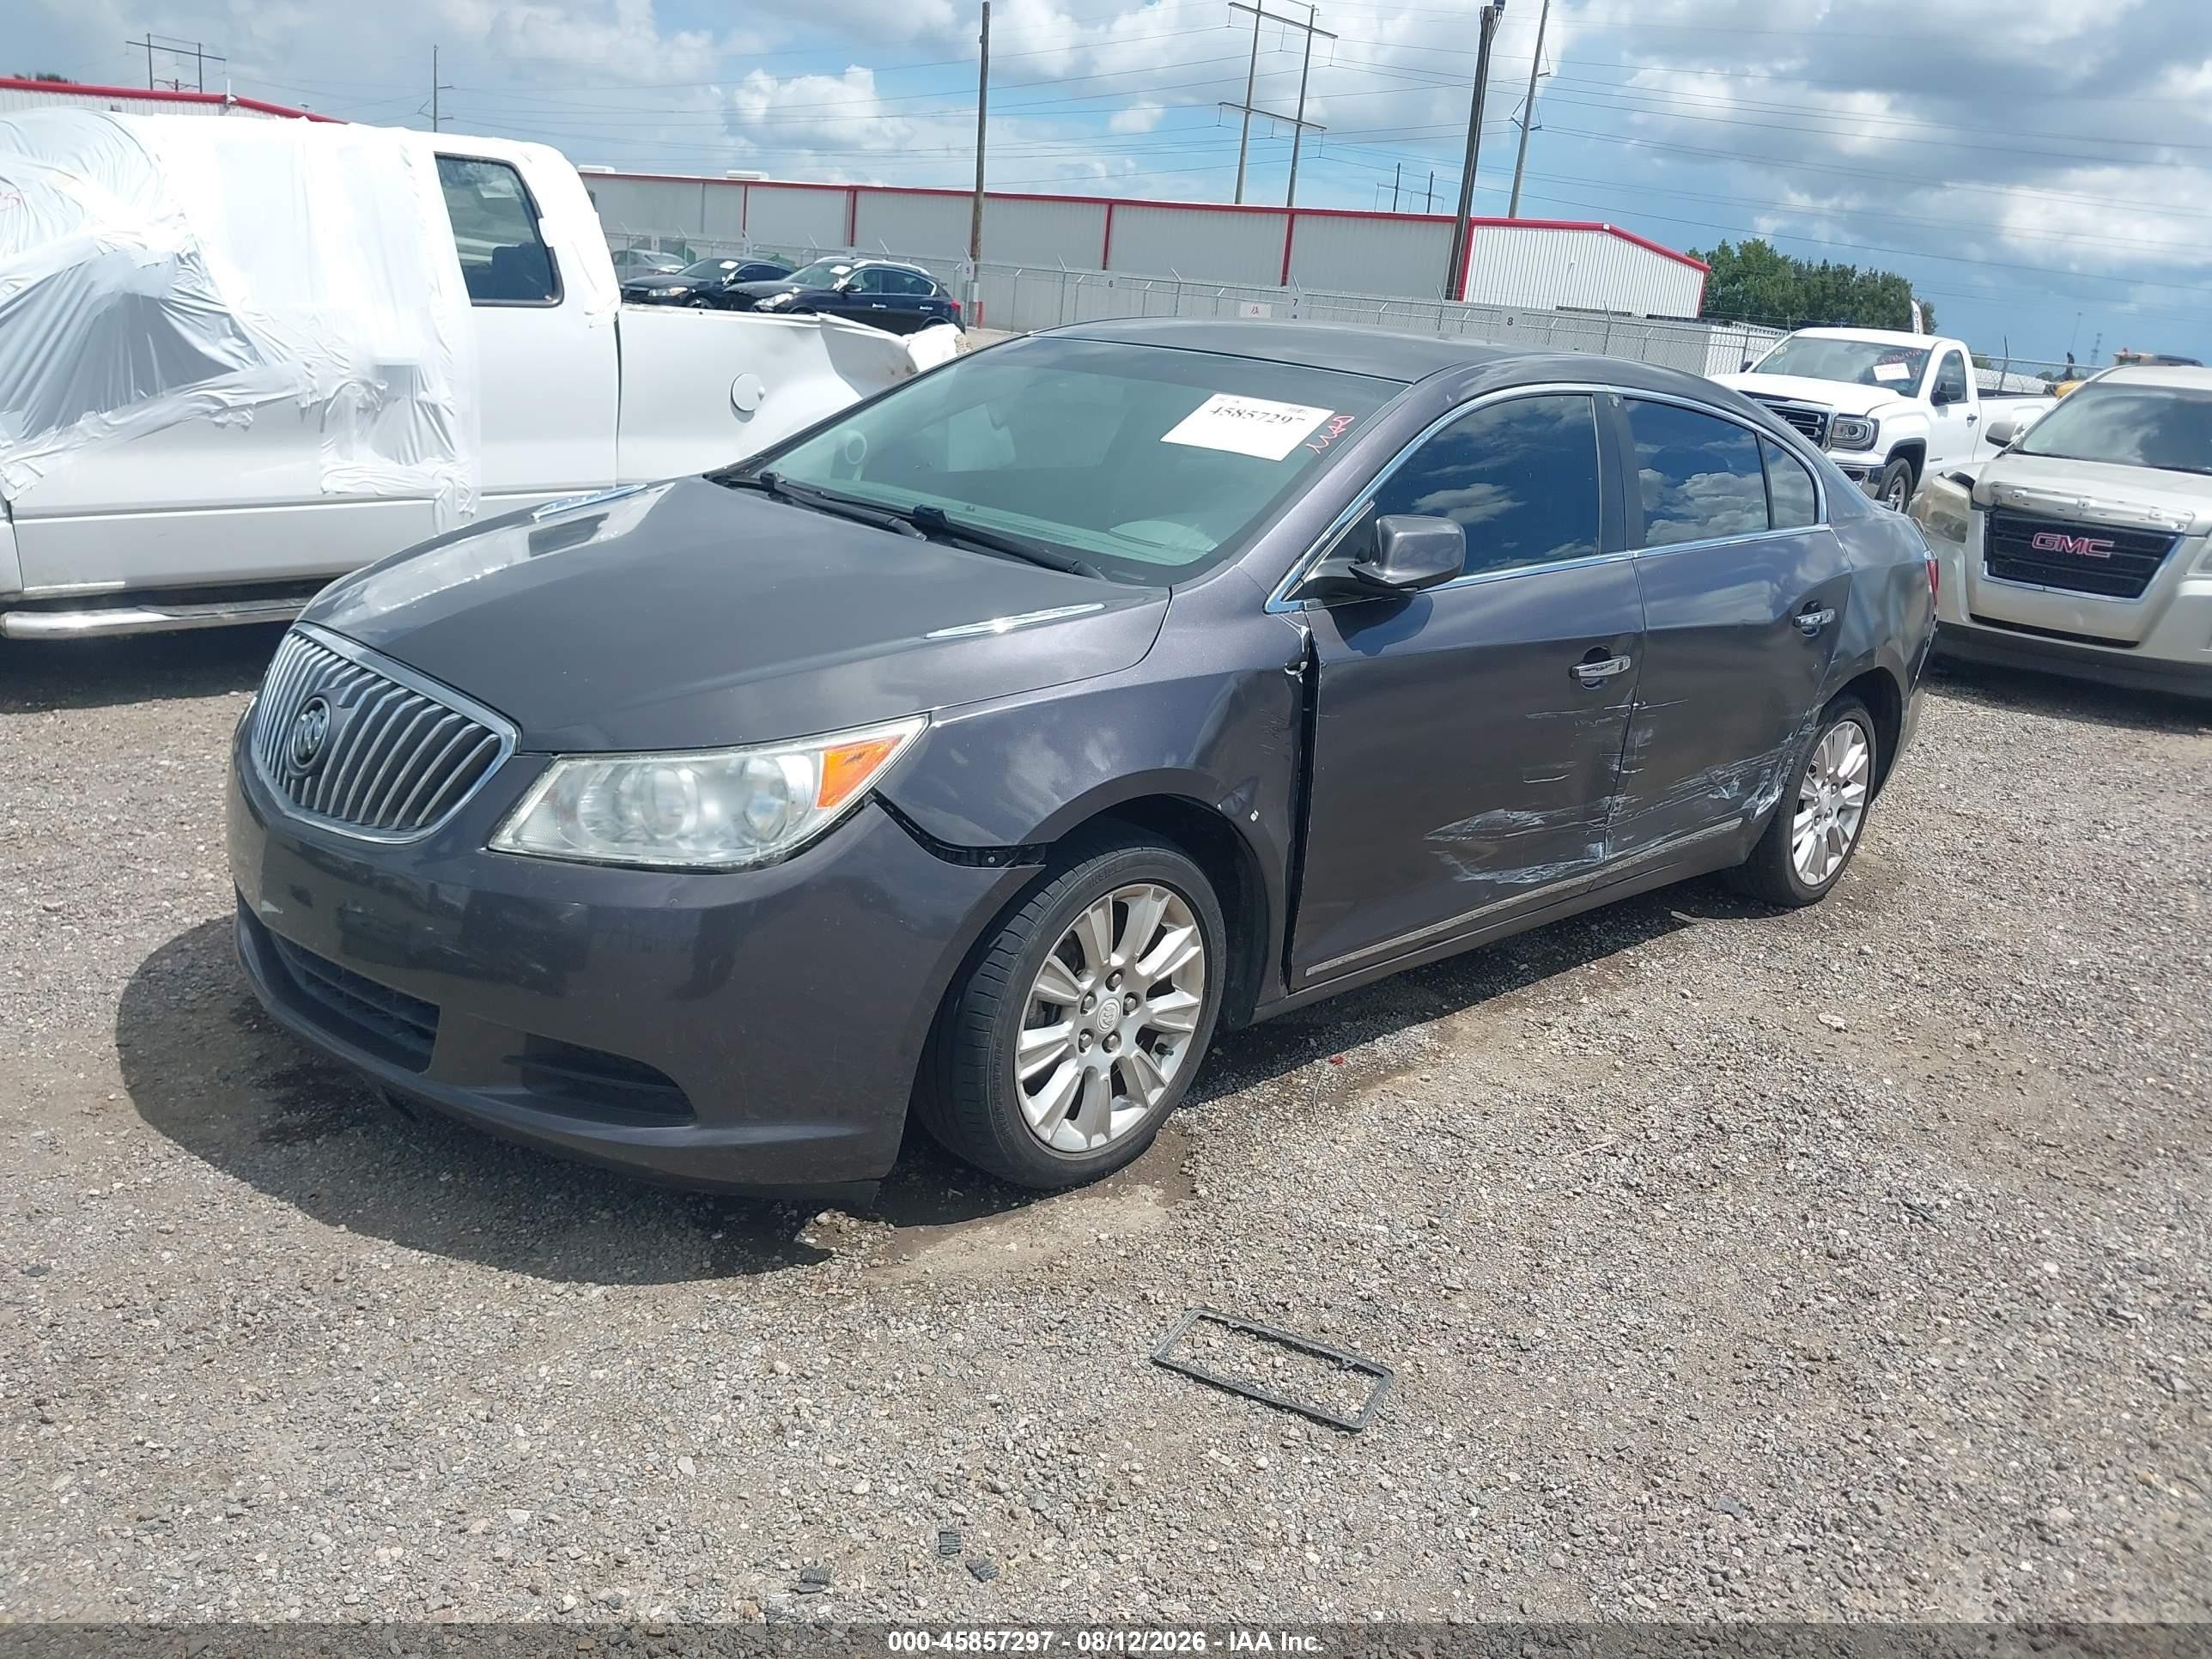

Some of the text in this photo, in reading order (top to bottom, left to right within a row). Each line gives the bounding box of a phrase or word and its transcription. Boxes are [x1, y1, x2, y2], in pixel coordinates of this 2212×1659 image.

[1292, 298, 1298, 307] 7
[1507, 316, 1514, 326] 8
[2032, 532, 2116, 558] GMC
